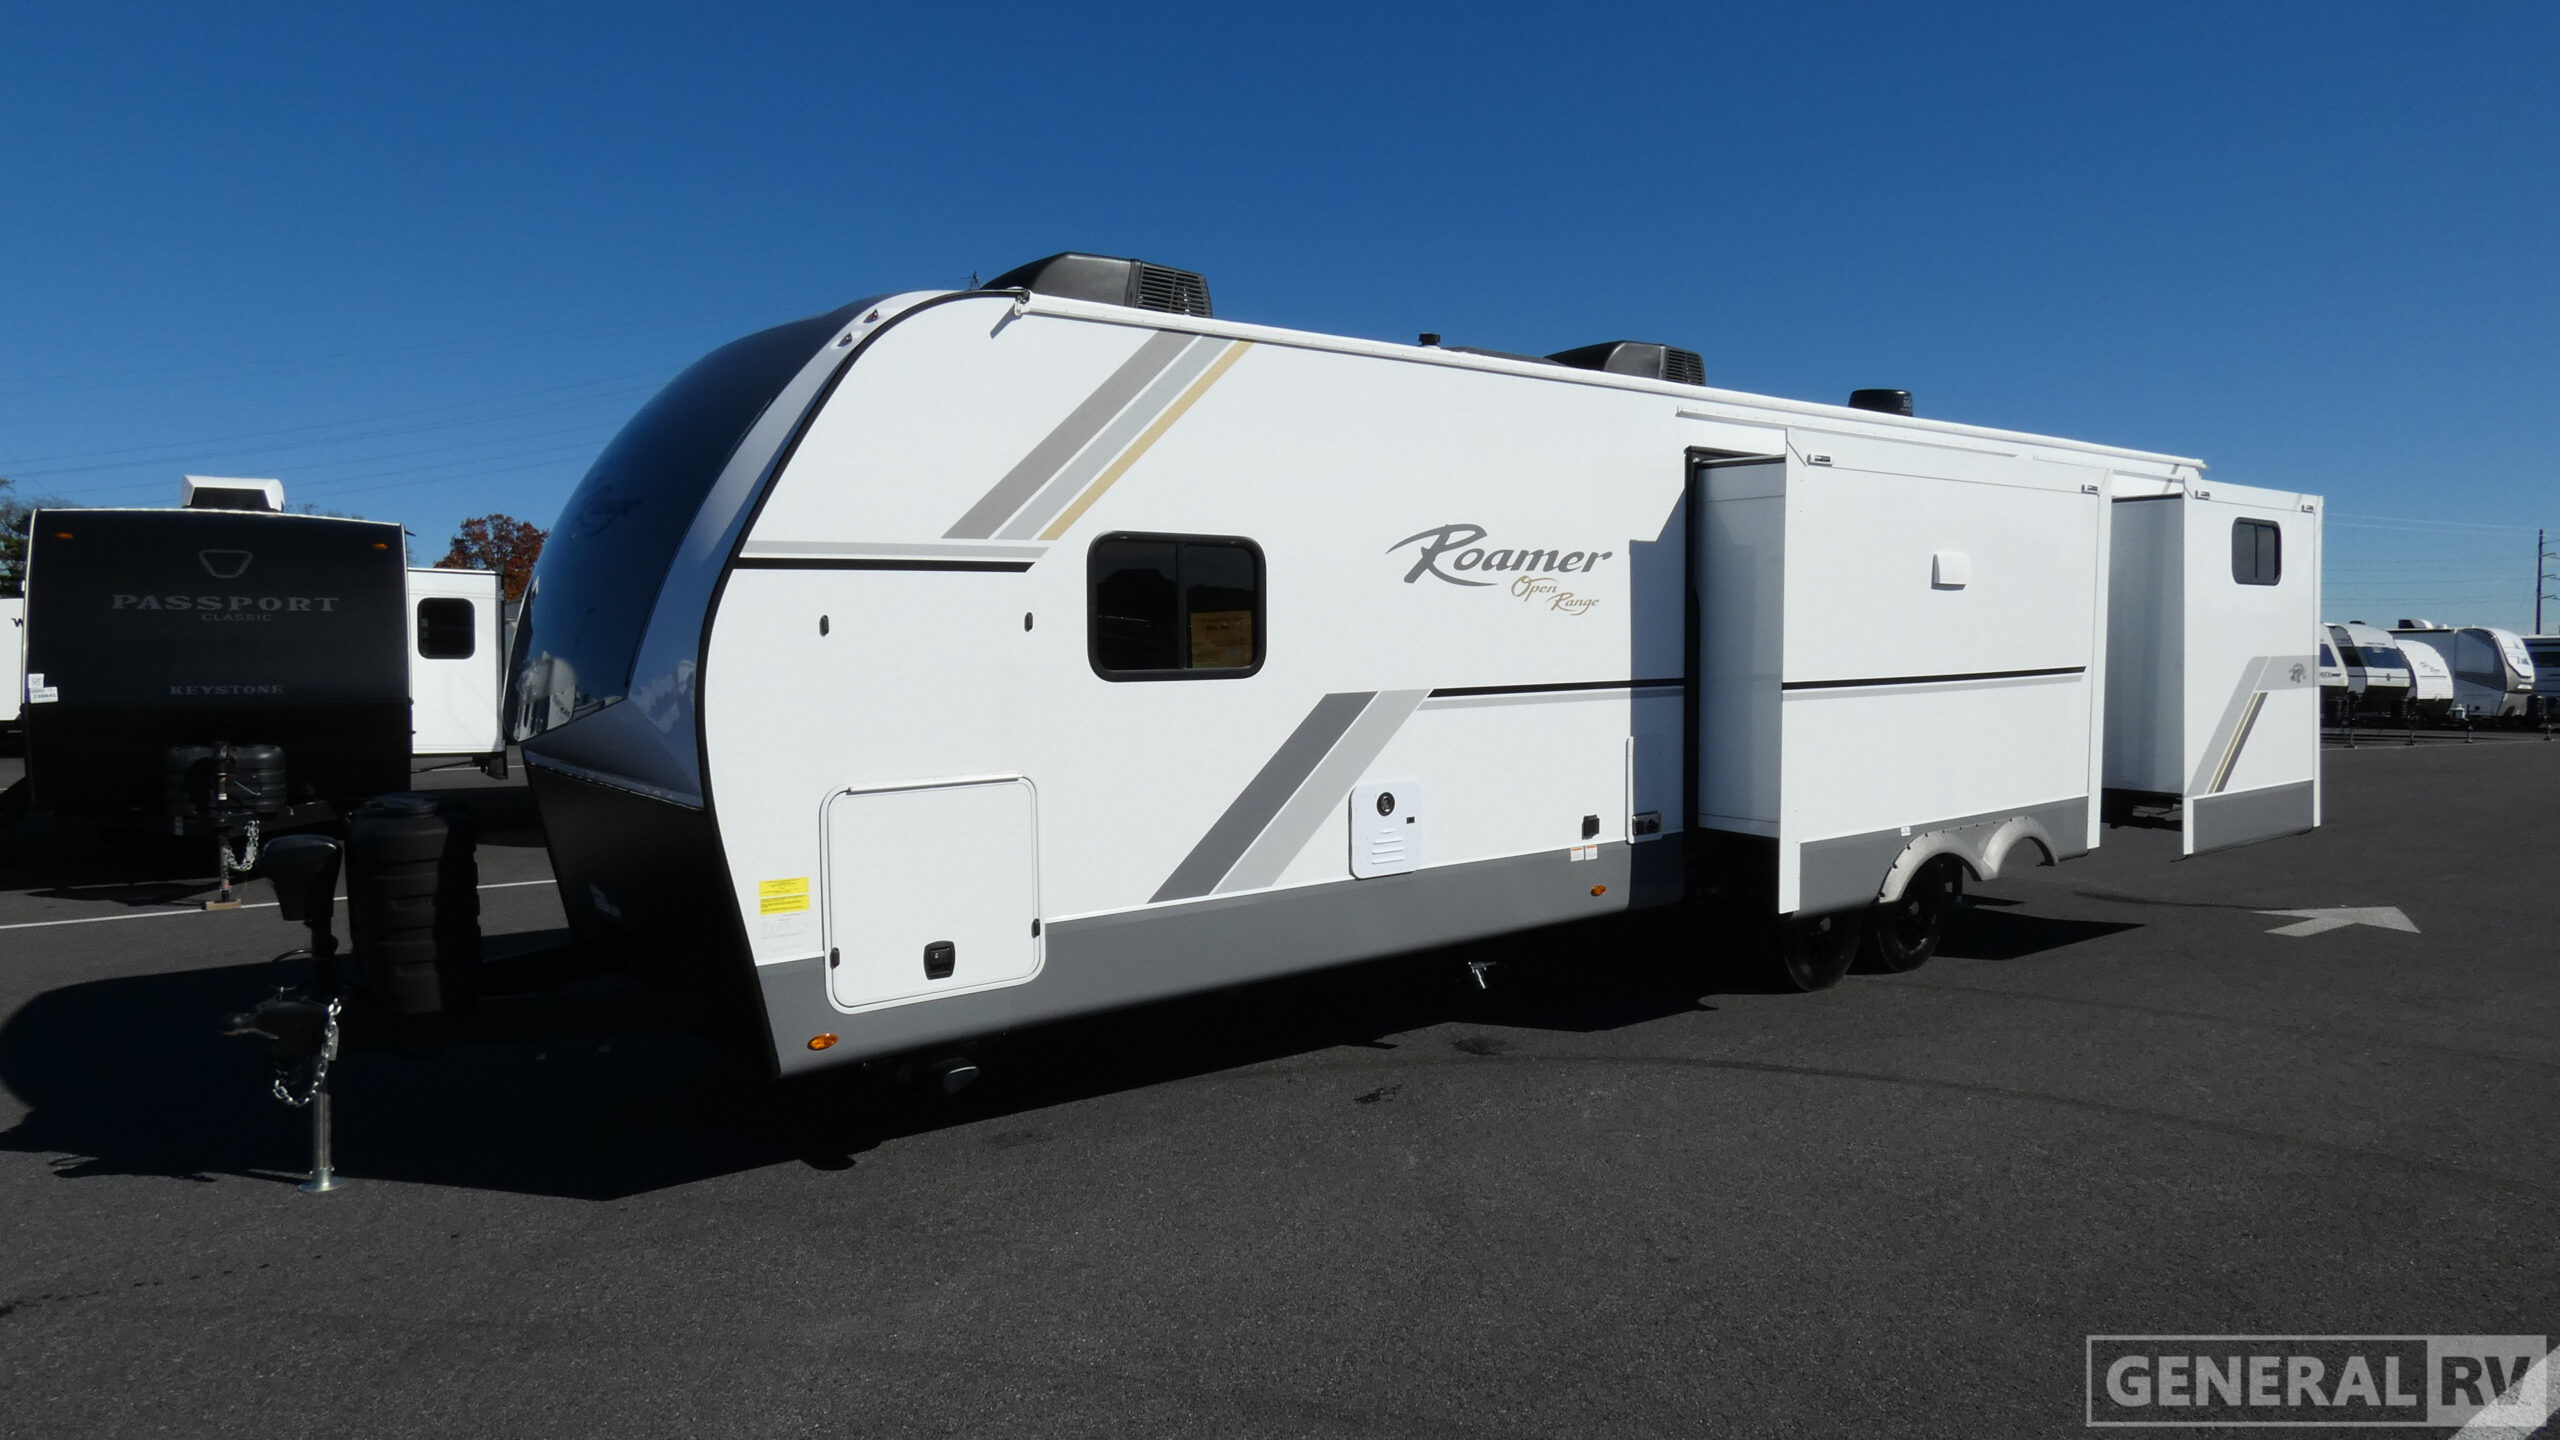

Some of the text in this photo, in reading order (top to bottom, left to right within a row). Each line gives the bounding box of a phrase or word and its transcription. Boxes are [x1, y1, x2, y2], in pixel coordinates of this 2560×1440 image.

[1385, 523, 1613, 587] Roamer
[1511, 575, 1559, 602] Open
[111, 594, 340, 612] PASSPORT
[1547, 592, 1600, 616] Range
[201, 613, 273, 622] CLASSIC
[169, 684, 285, 696] KEYSTONE
